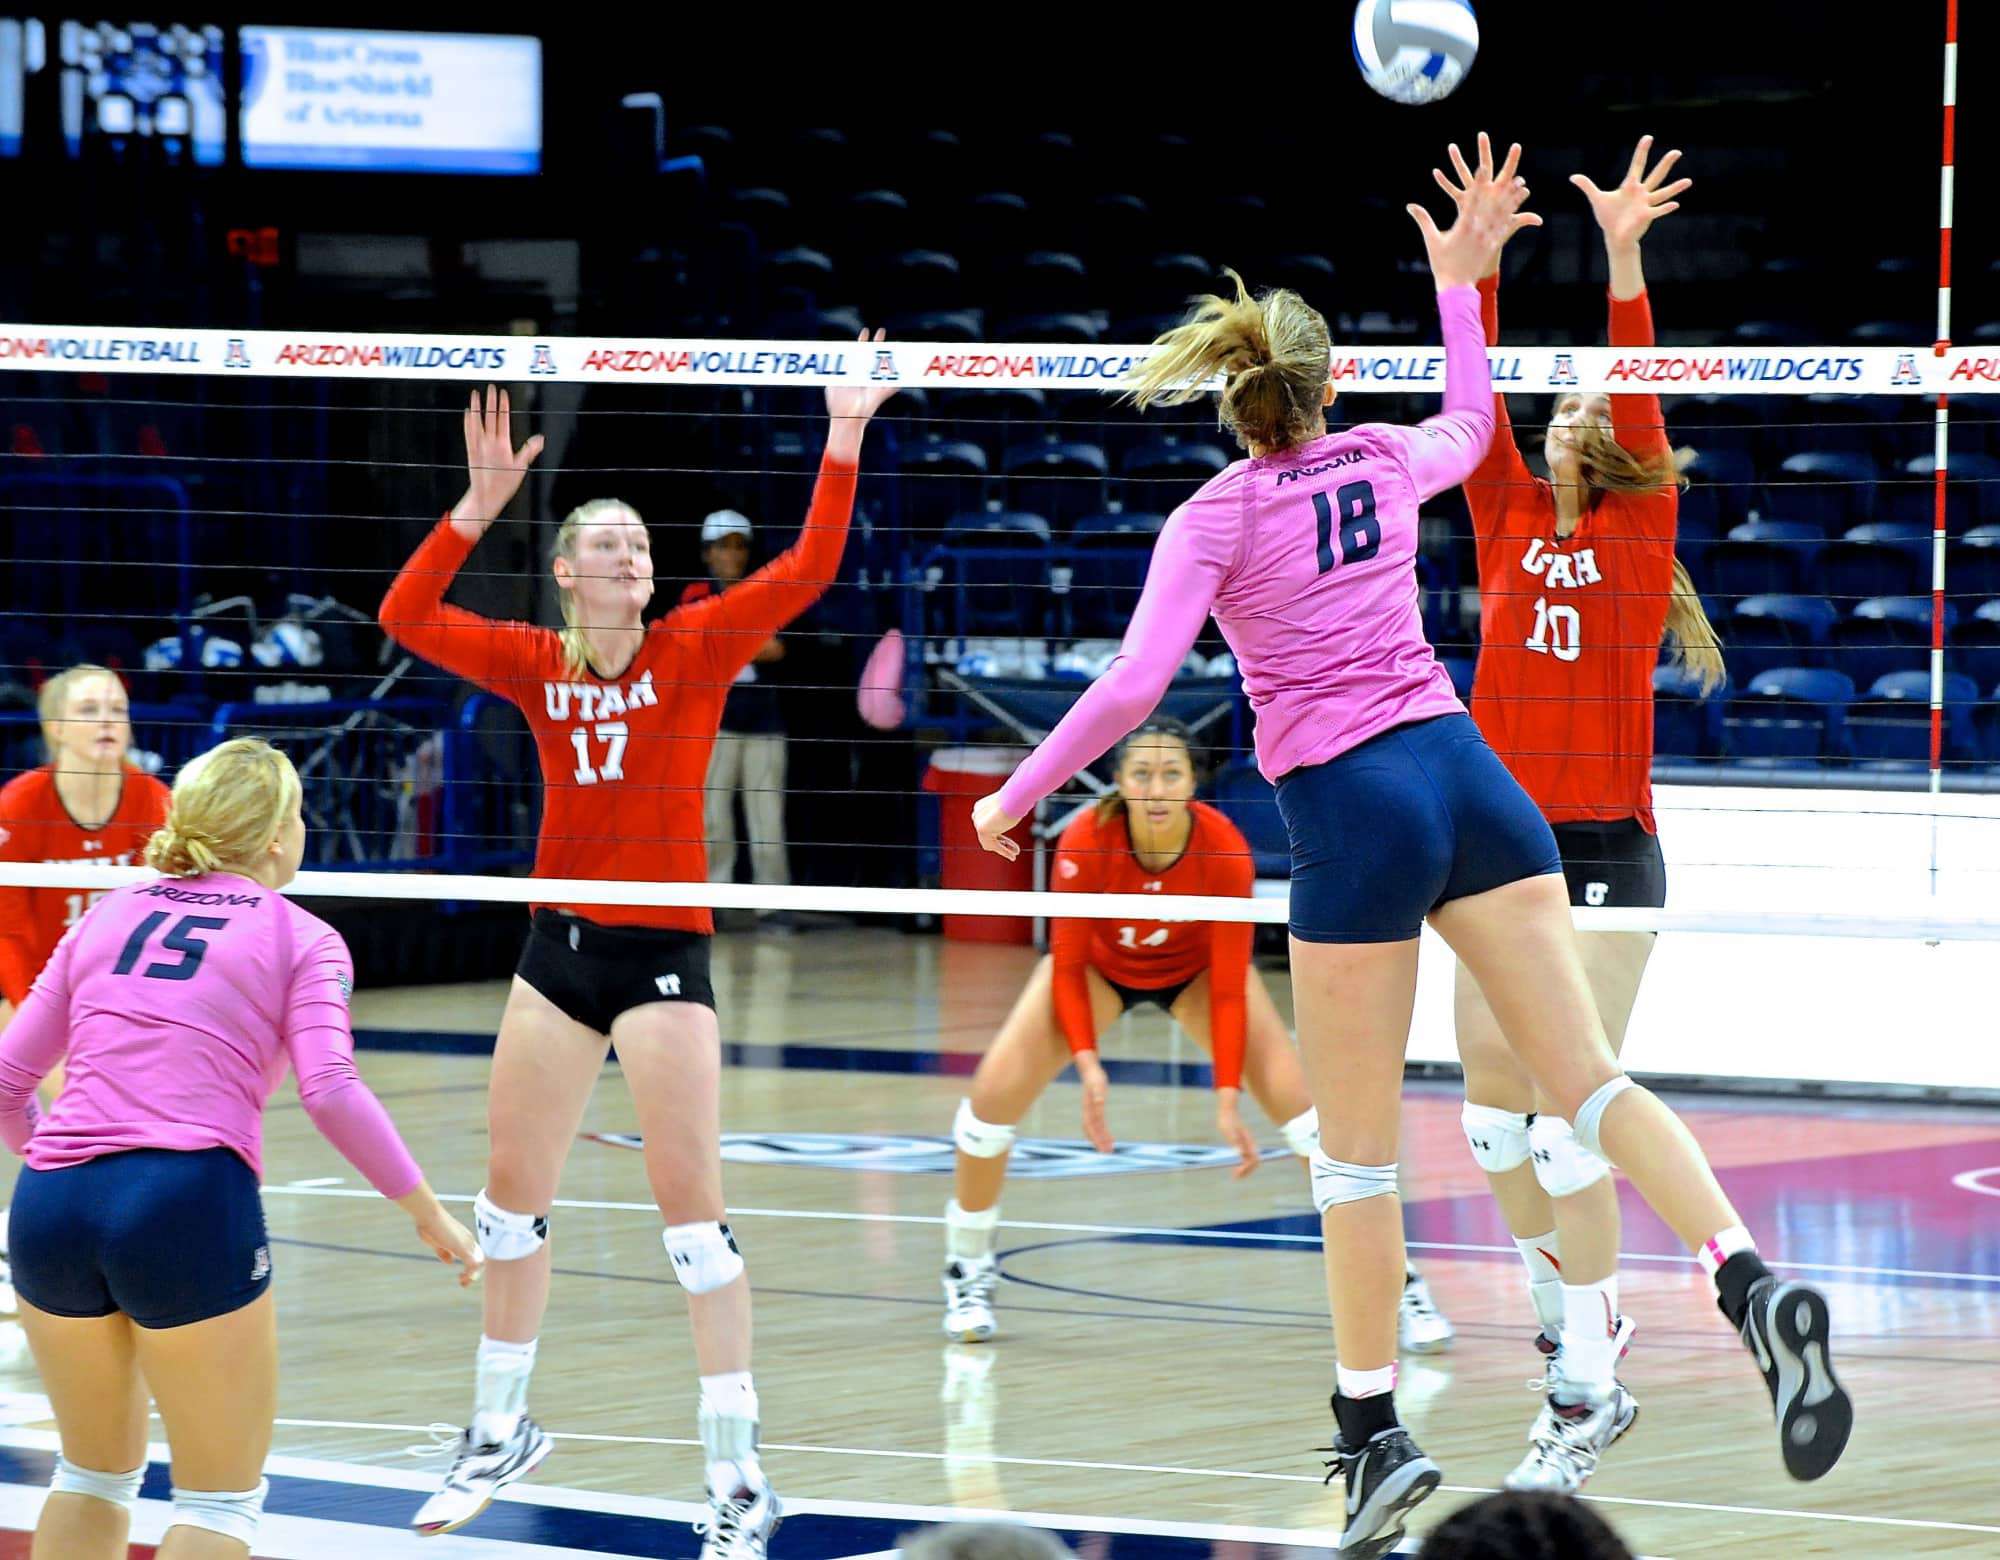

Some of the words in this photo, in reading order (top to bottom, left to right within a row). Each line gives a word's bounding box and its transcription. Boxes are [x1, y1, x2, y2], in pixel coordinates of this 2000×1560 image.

[1311, 479, 1381, 575] 18
[1524, 595, 1581, 662] 10
[543, 668, 659, 721] UTAH
[569, 720, 629, 785] 17
[132, 884, 262, 908] ARIZONA
[111, 910, 231, 981] 15
